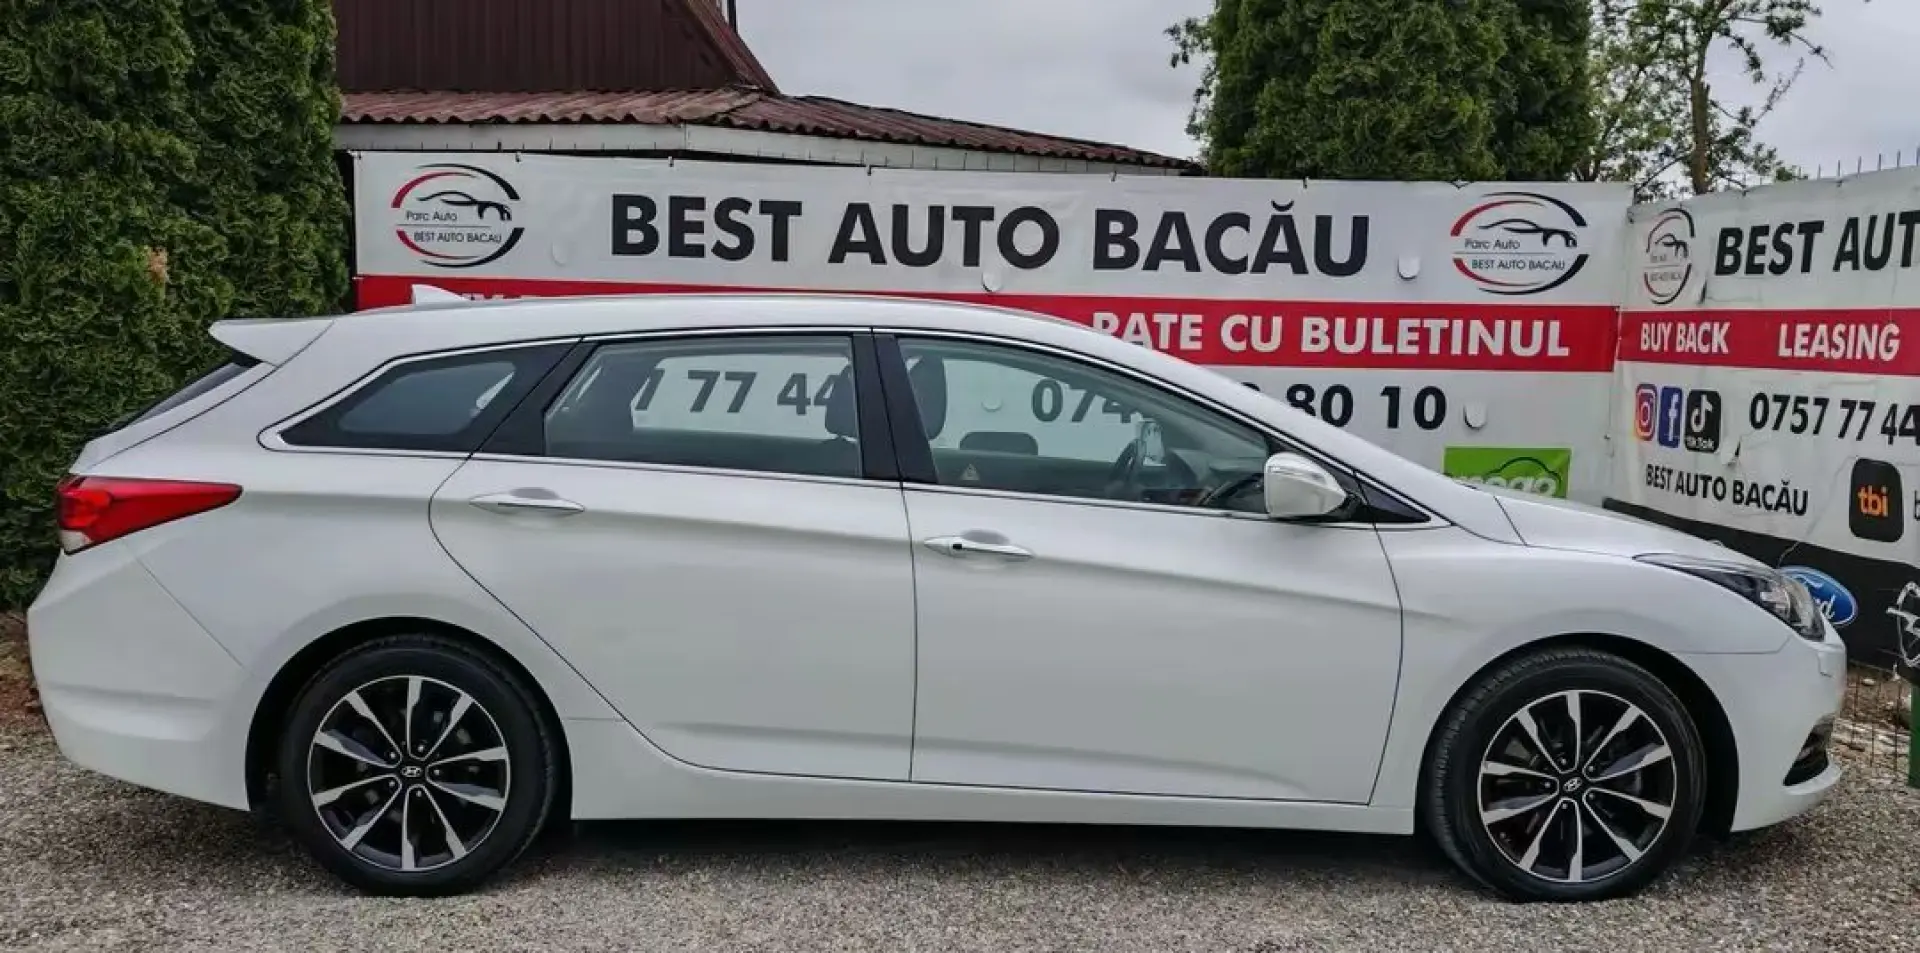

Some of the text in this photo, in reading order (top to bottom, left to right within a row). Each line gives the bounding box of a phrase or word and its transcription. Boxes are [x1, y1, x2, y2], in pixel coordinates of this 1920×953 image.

[433, 211, 458, 221] Auto
[611, 193, 1370, 278] BEST AUTO BACĂU
[413, 232, 435, 243] BEST
[437, 232, 464, 243] AUTO
[1493, 239, 1521, 250] Auto
[1713, 220, 1826, 276] BEST
[1471, 260, 1494, 269] BEST
[1498, 260, 1526, 270] AUTO
[1220, 314, 1283, 353] CU
[1301, 316, 1570, 357] BULETINUL
[1640, 321, 1731, 354] BUY BACK
[1777, 322, 1901, 362] LEASING
[687, 369, 757, 414] 77
[1379, 385, 1447, 431] 10
[1749, 391, 1830, 436] 0757
[1837, 399, 1876, 442] 77
[1646, 463, 1809, 517] BEST AUTO BACĂU
[1857, 484, 1889, 517] tbi
